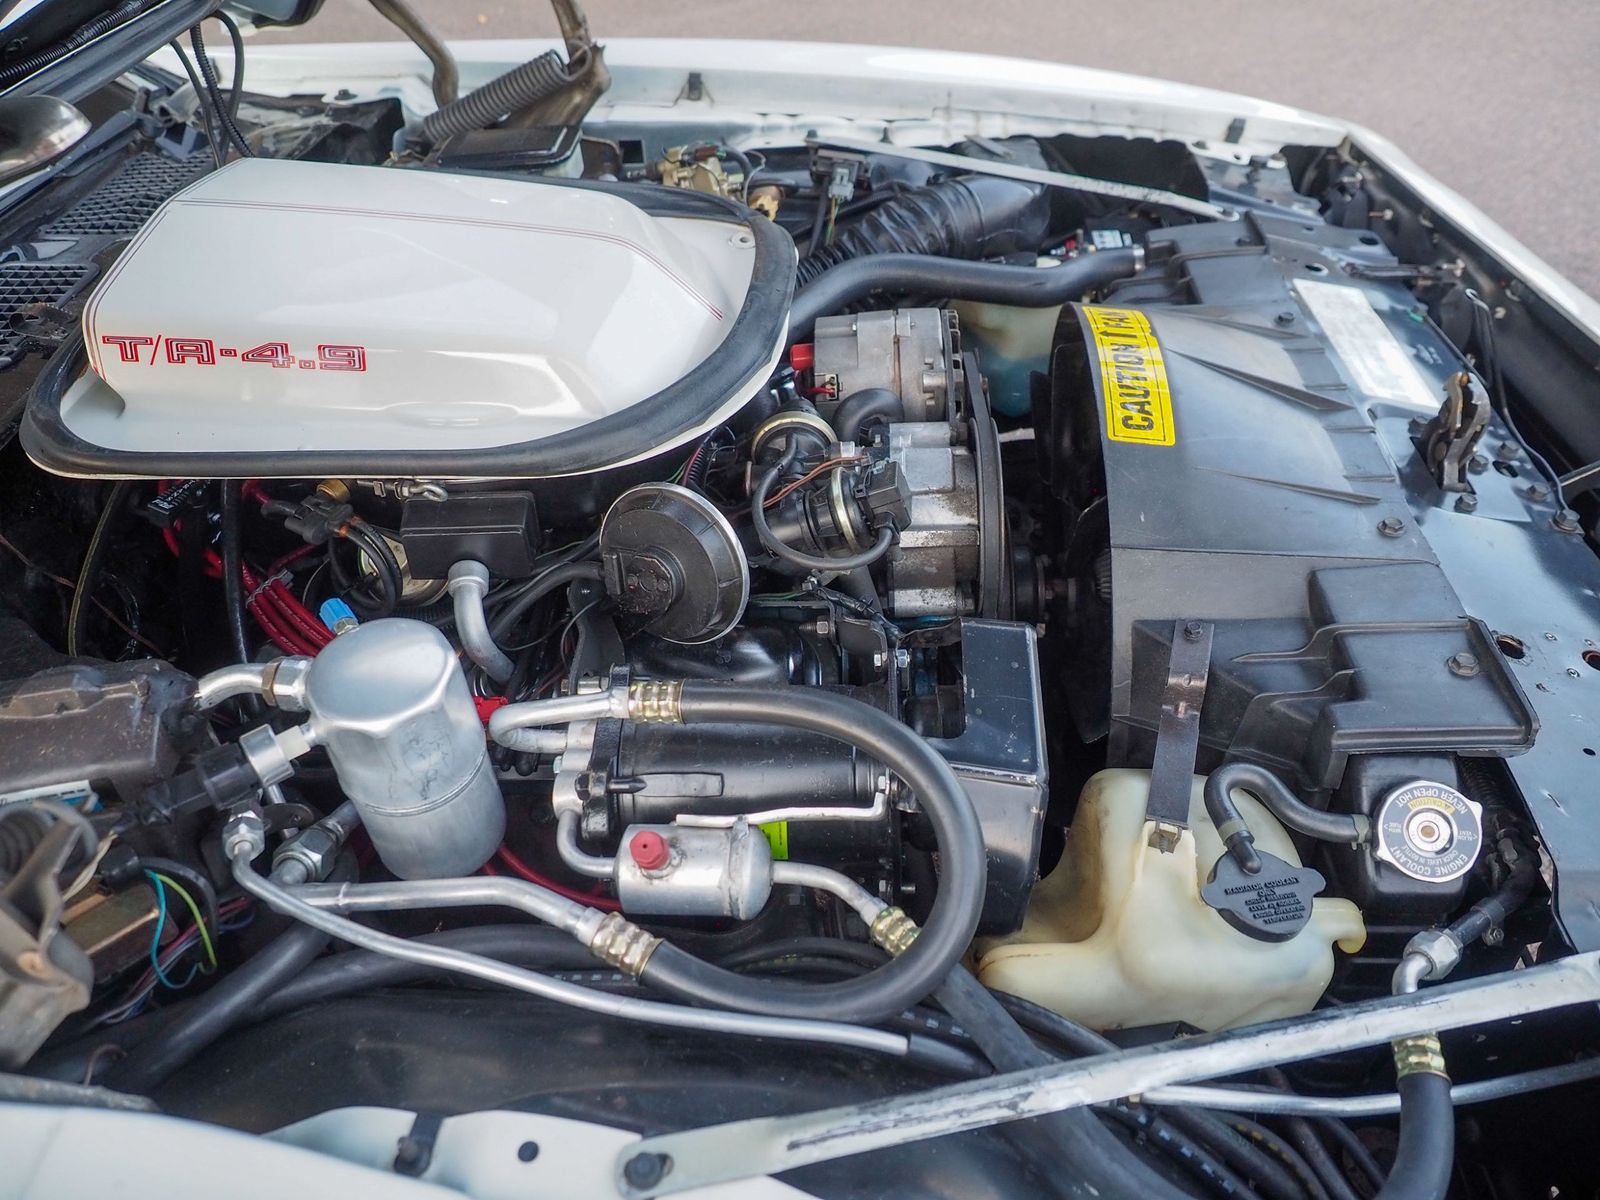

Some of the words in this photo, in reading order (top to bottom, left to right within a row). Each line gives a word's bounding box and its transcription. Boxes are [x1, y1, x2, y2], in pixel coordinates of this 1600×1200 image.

[1098, 311, 1134, 329] FAN
[1110, 343, 1154, 431] CAUTION
[1395, 792, 1413, 808] HOT
[1413, 788, 1439, 798] OPEN
[1411, 797, 1443, 809] CAUTION
[1441, 790, 1468, 814] NEVER
[1390, 846, 1431, 876] COOLANT
[1427, 857, 1443, 866] LEVEL
[1434, 854, 1469, 876] ENGINE
[1443, 850, 1459, 864] CHECK
[1224, 883, 1264, 896] RADIATOR
